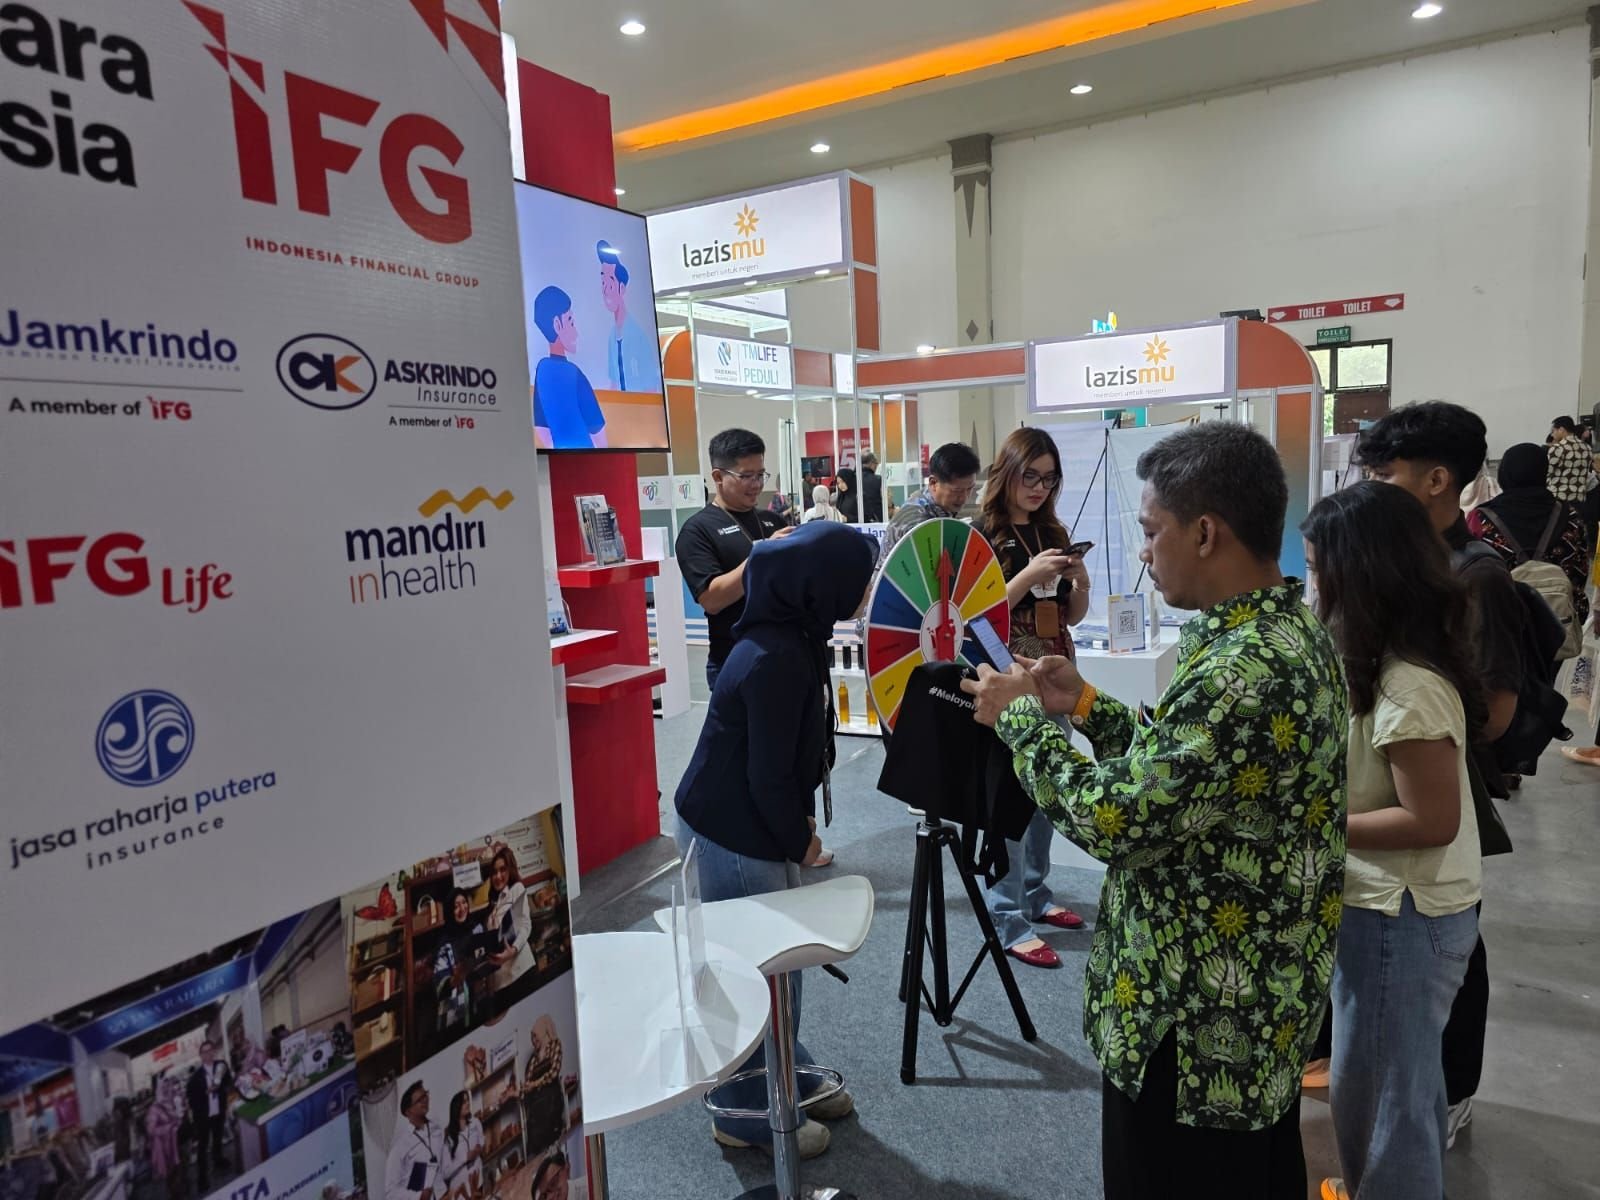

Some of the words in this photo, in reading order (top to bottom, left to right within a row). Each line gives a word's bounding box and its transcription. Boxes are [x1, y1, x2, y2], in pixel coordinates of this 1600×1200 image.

[0, 3, 154, 101] ara
[0, 90, 137, 188] sia
[245, 236, 343, 266] INDONESIA
[351, 256, 430, 281] FINANCIAL
[435, 271, 480, 289] GROUP
[682, 235, 765, 269] lazismu
[1298, 306, 1326, 319] TOILET
[1343, 301, 1371, 314] TOILET
[0, 310, 238, 363] Jamkrindo
[1318, 328, 1350, 337] TOILET
[384, 359, 498, 389] ASKRINDO
[743, 367, 779, 385] PEDULI
[1086, 365, 1175, 388] lazismu
[9, 397, 26, 413] A
[31, 398, 117, 416] member
[122, 400, 142, 416] of
[417, 386, 498, 405] Insurance
[389, 416, 398, 426] A
[400, 416, 439, 428] member
[442, 416, 452, 427] of
[345, 512, 486, 562] mandiri
[162, 562, 234, 614] Life
[349, 551, 477, 604] inhealth
[10, 824, 77, 869] jasa
[85, 791, 189, 842] raharja
[194, 770, 278, 814] putera
[87, 817, 225, 870] insurance
